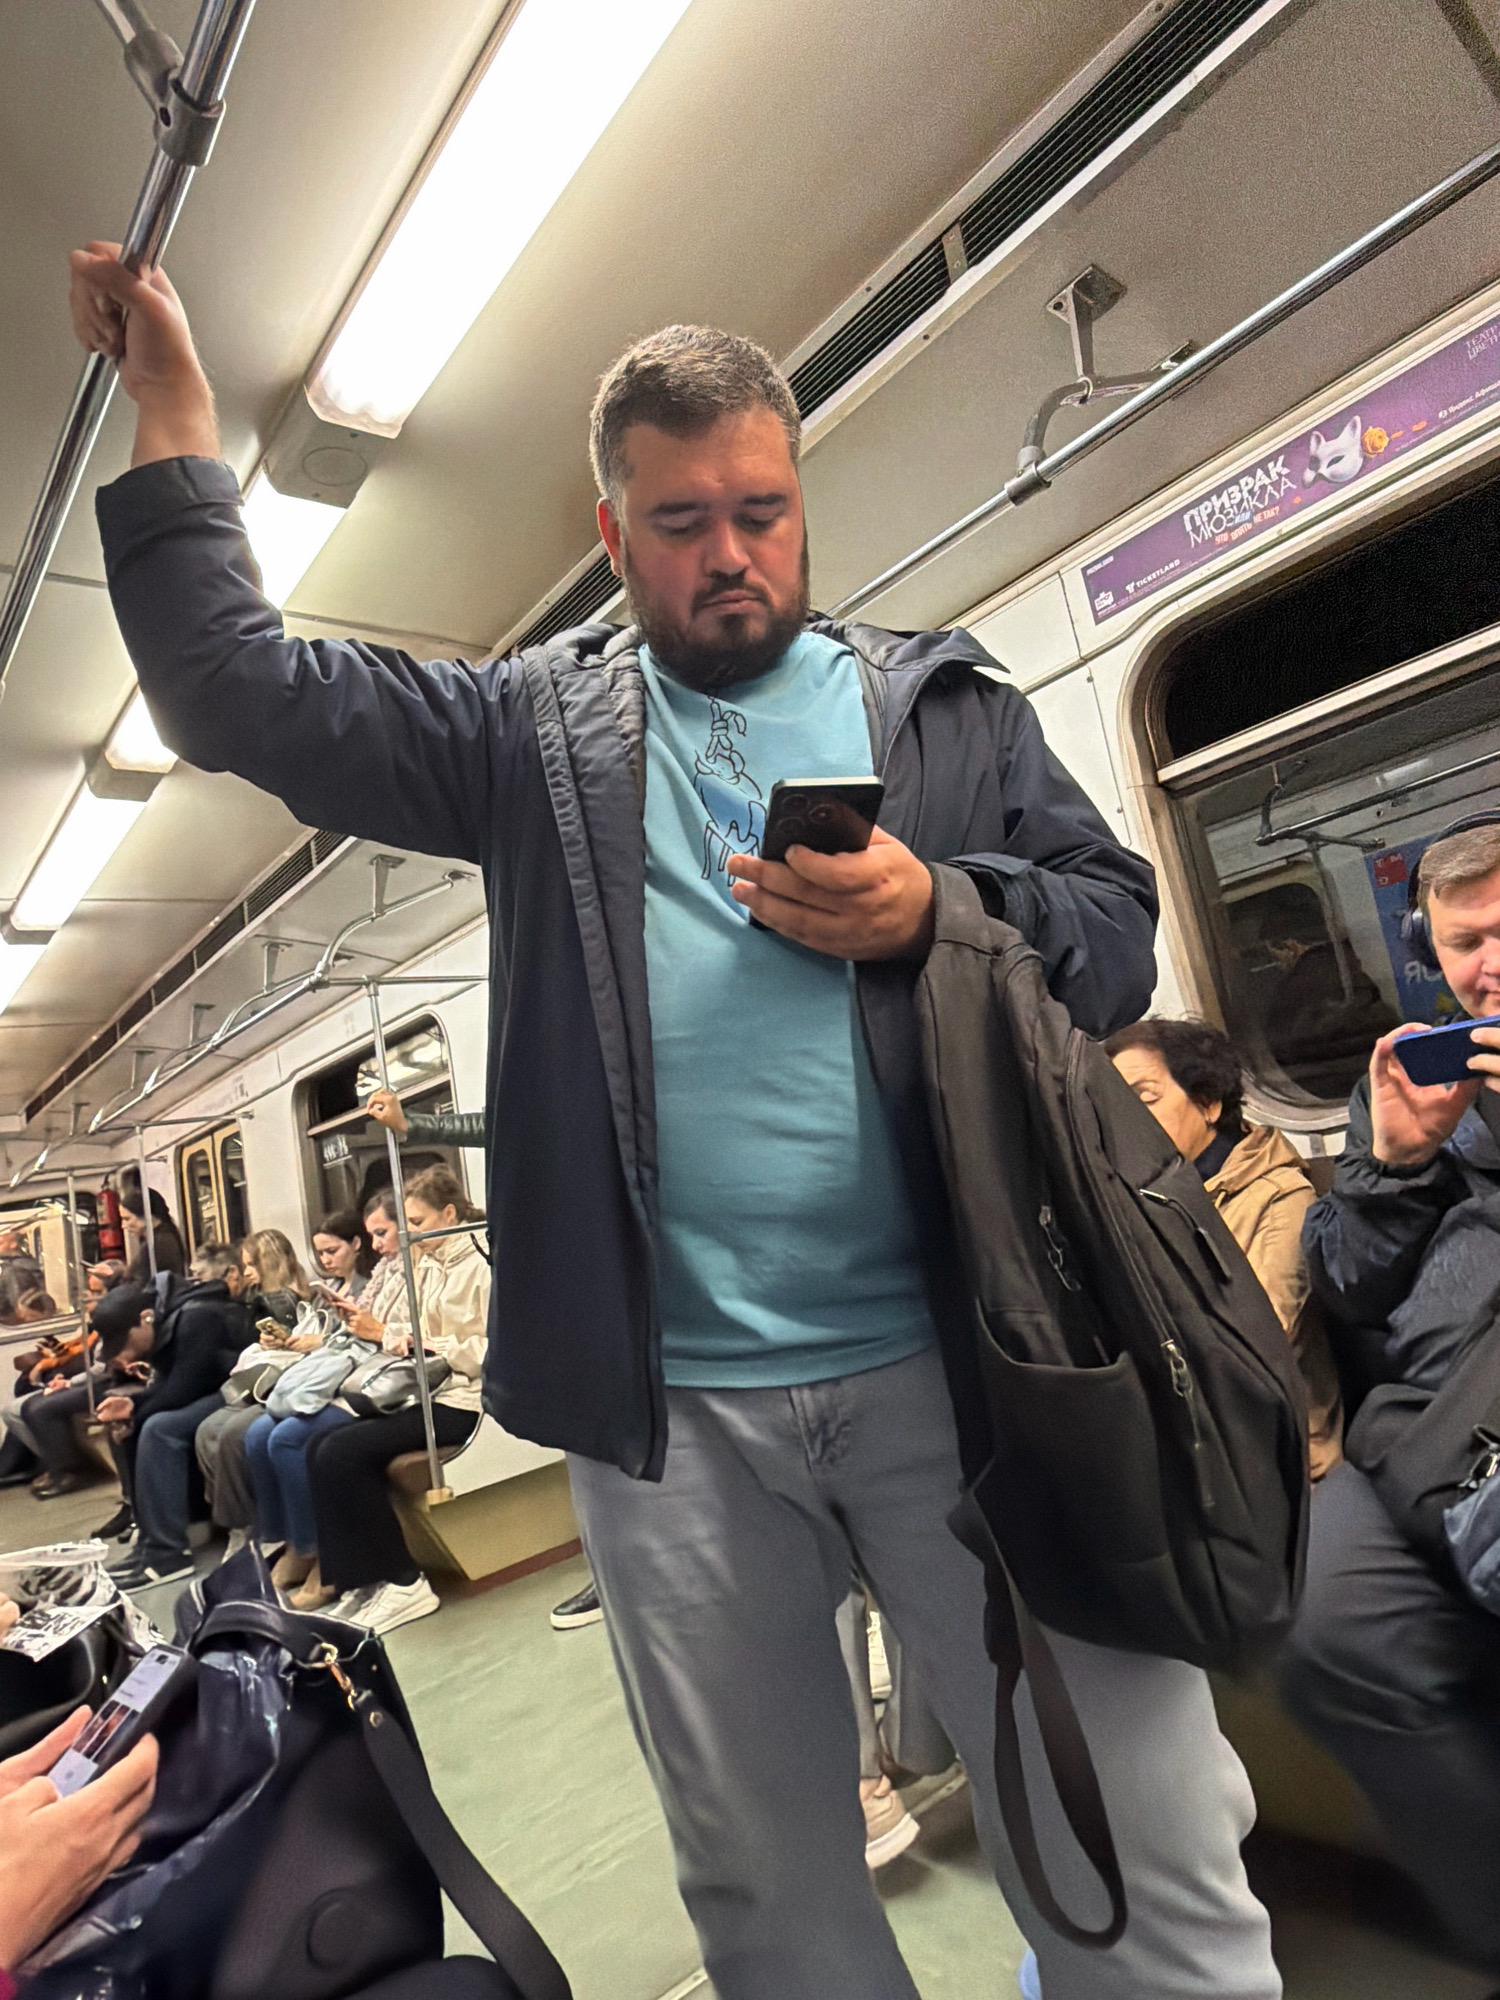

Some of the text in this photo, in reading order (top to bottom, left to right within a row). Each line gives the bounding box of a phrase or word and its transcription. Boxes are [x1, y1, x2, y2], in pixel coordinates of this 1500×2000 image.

[1183, 454, 1291, 532] ПРИЗРАК
[1189, 476, 1298, 548] МЮЗИКЛА
[1214, 506, 1280, 544] ЧТО ОПЯТЬ НЕ ТАК?
[1135, 558, 1181, 588] TICKETLAND
